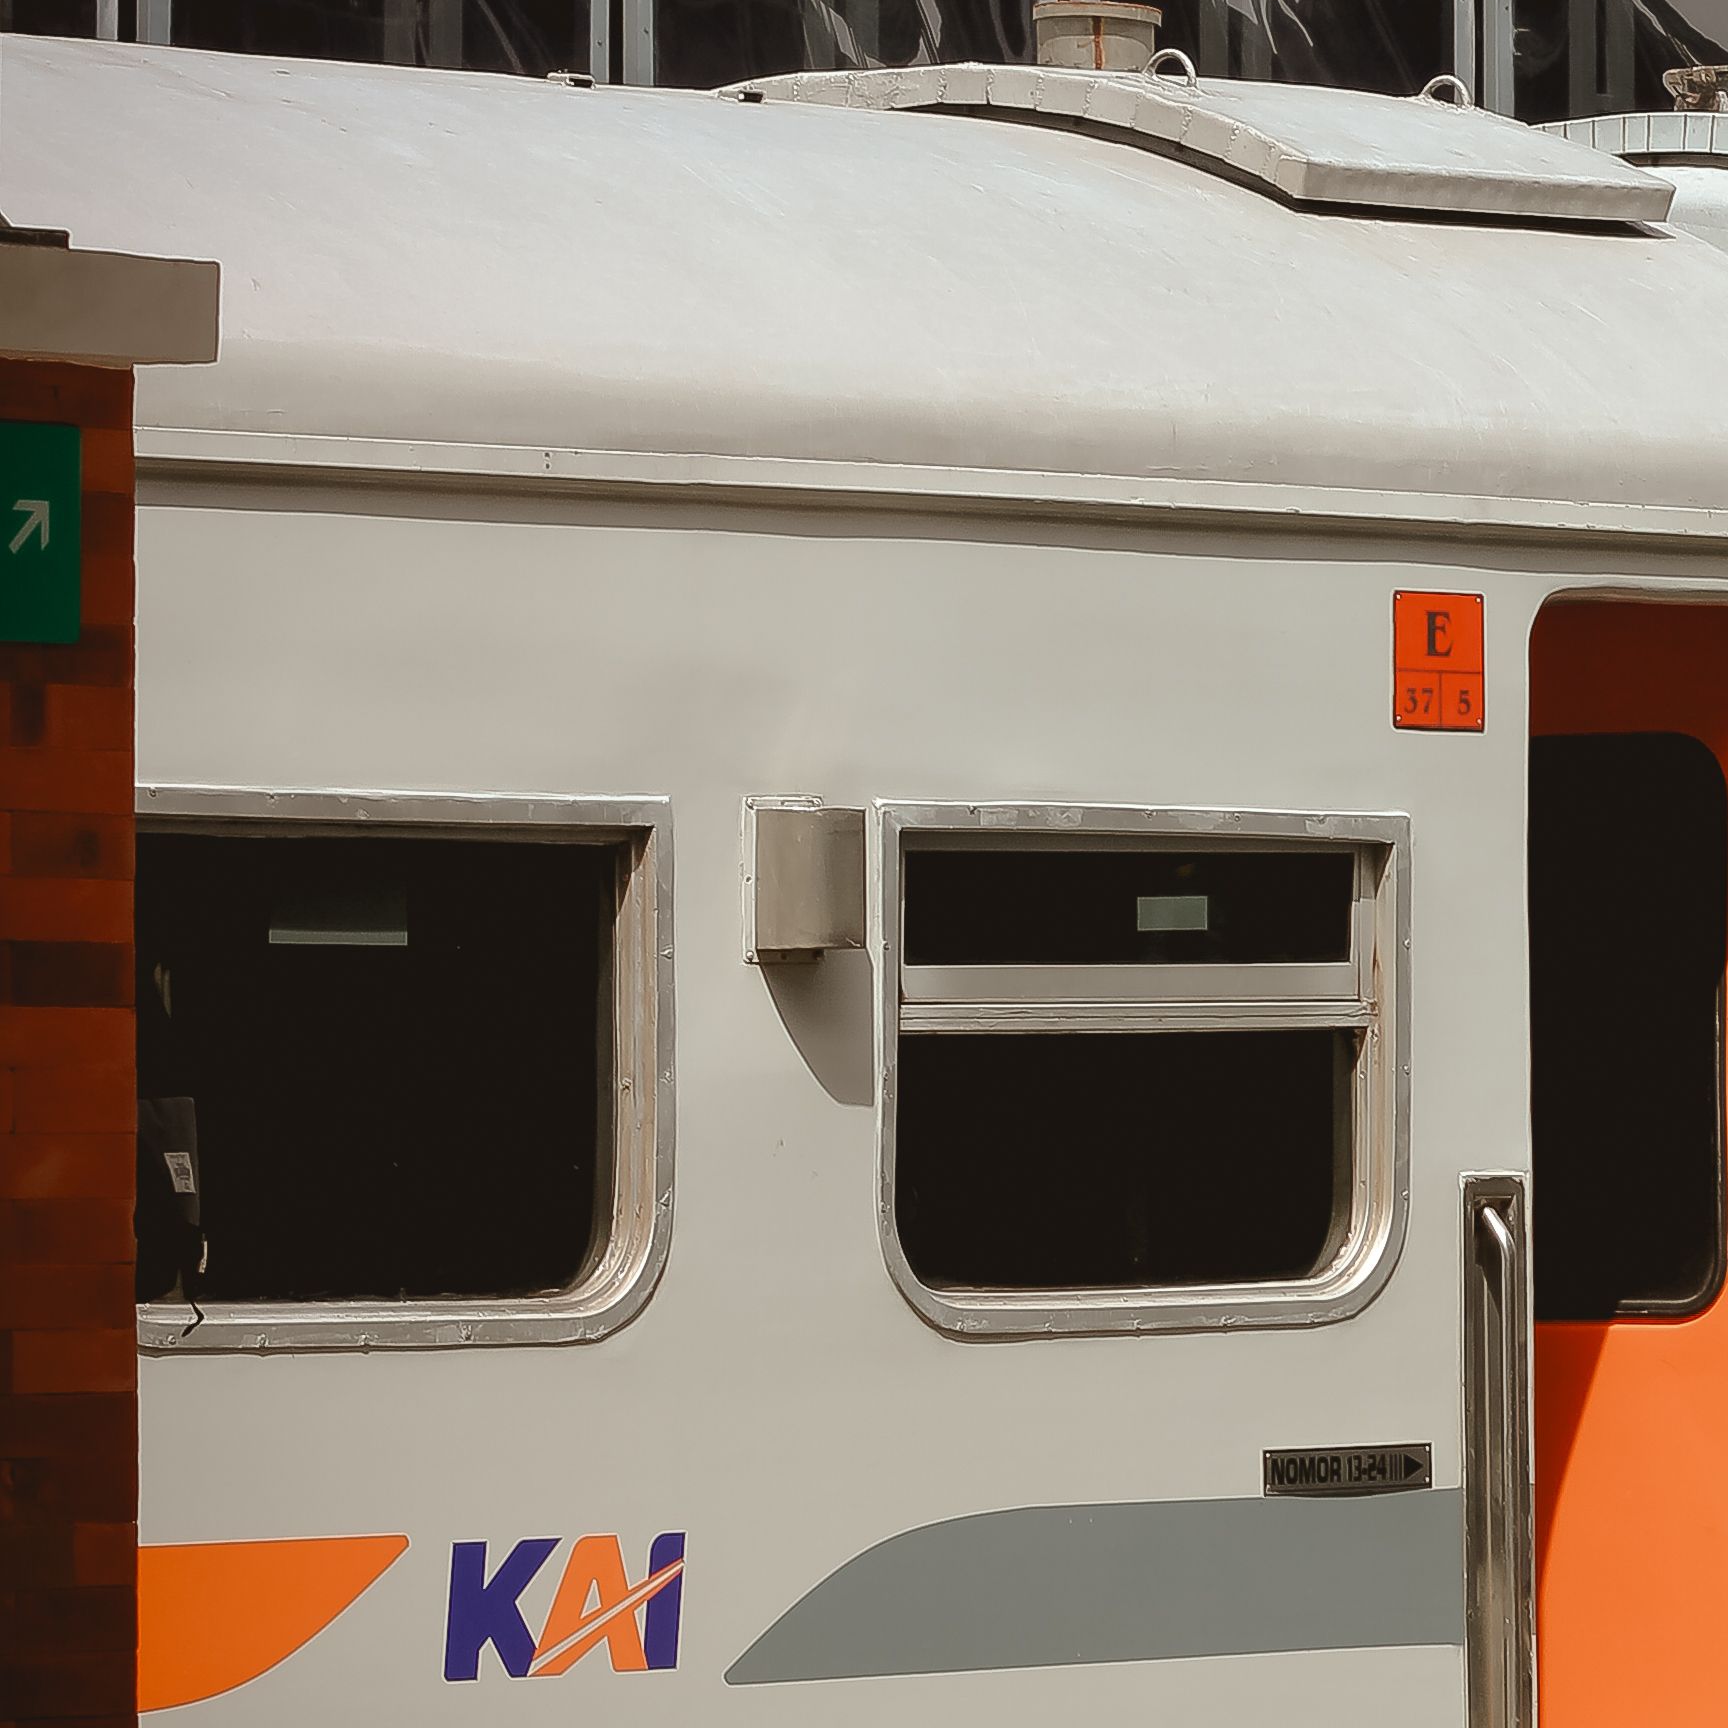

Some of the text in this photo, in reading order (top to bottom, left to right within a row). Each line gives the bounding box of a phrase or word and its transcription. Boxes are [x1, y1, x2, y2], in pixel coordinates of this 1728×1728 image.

[1425, 609, 1454, 658] E
[1403, 687, 1434, 715] 37
[1457, 689, 1472, 716] 5
[1271, 1453, 1388, 1486] NOMOR 13-24
[444, 1531, 687, 1683] KAI
